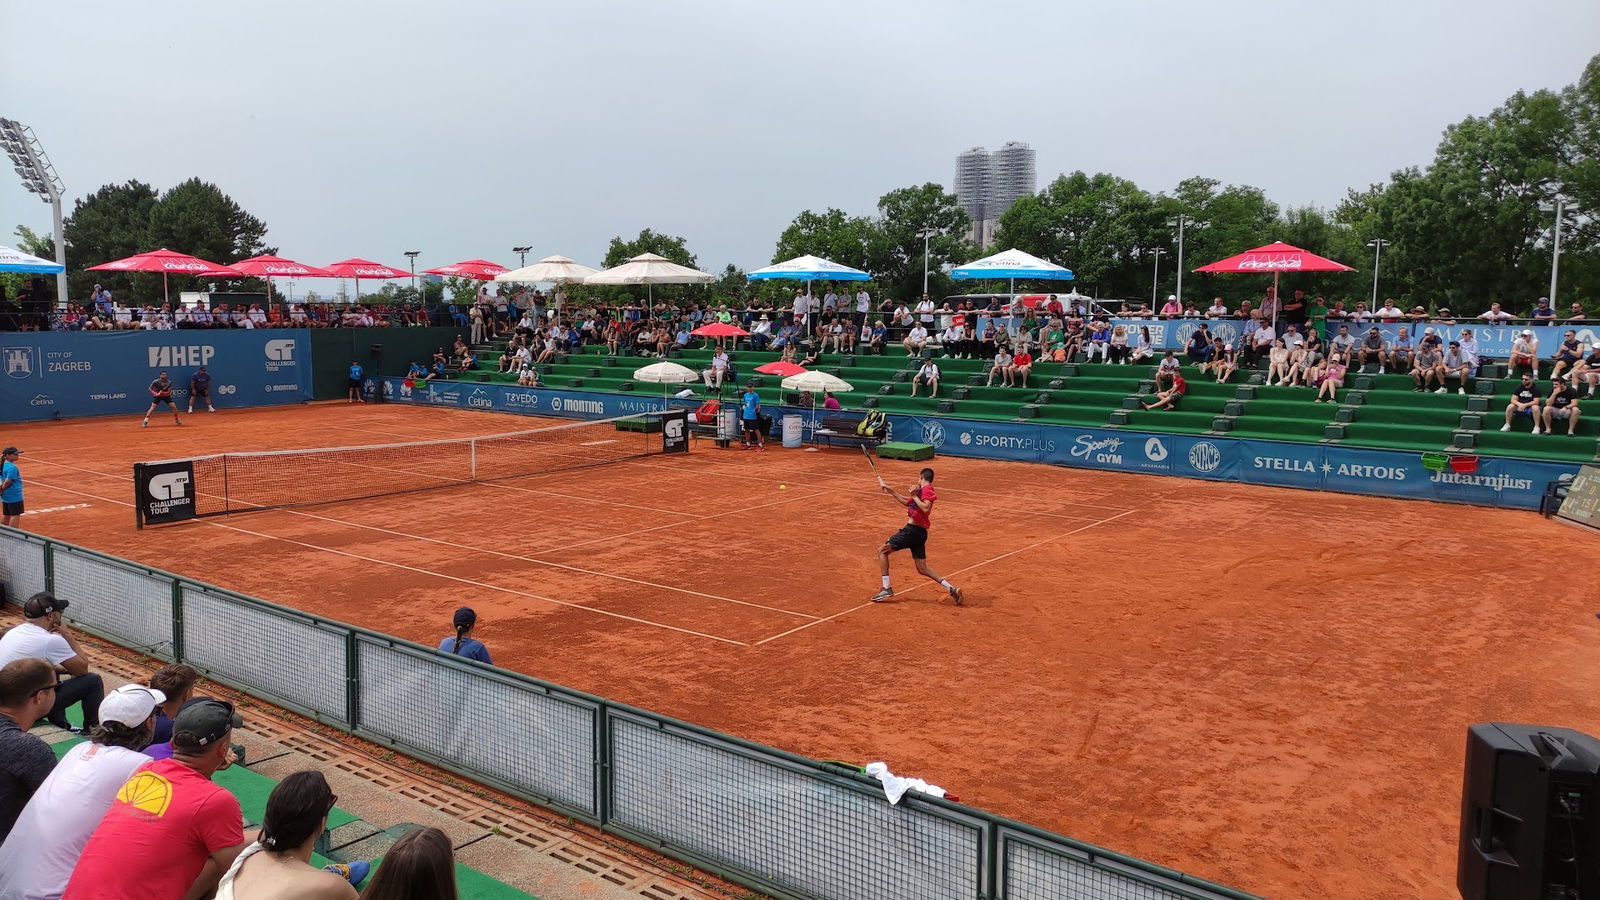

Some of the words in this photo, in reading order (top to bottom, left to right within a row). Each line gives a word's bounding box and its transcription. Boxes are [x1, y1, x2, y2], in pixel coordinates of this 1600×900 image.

[164, 263, 209, 271] Coca-Cola
[265, 265, 309, 273] Coca-Cola
[172, 345, 215, 366] HEP
[48, 361, 92, 372] ZAGREB
[468, 396, 493, 407] Cetina
[619, 401, 665, 413] MAISTRA
[1071, 434, 1125, 460] Sporting
[1096, 453, 1122, 465] GYM
[1254, 456, 1316, 473] STELLA
[1337, 463, 1406, 481] ARTOIS
[150, 497, 190, 509] CHALLENGER
[151, 507, 170, 515] TOUR
